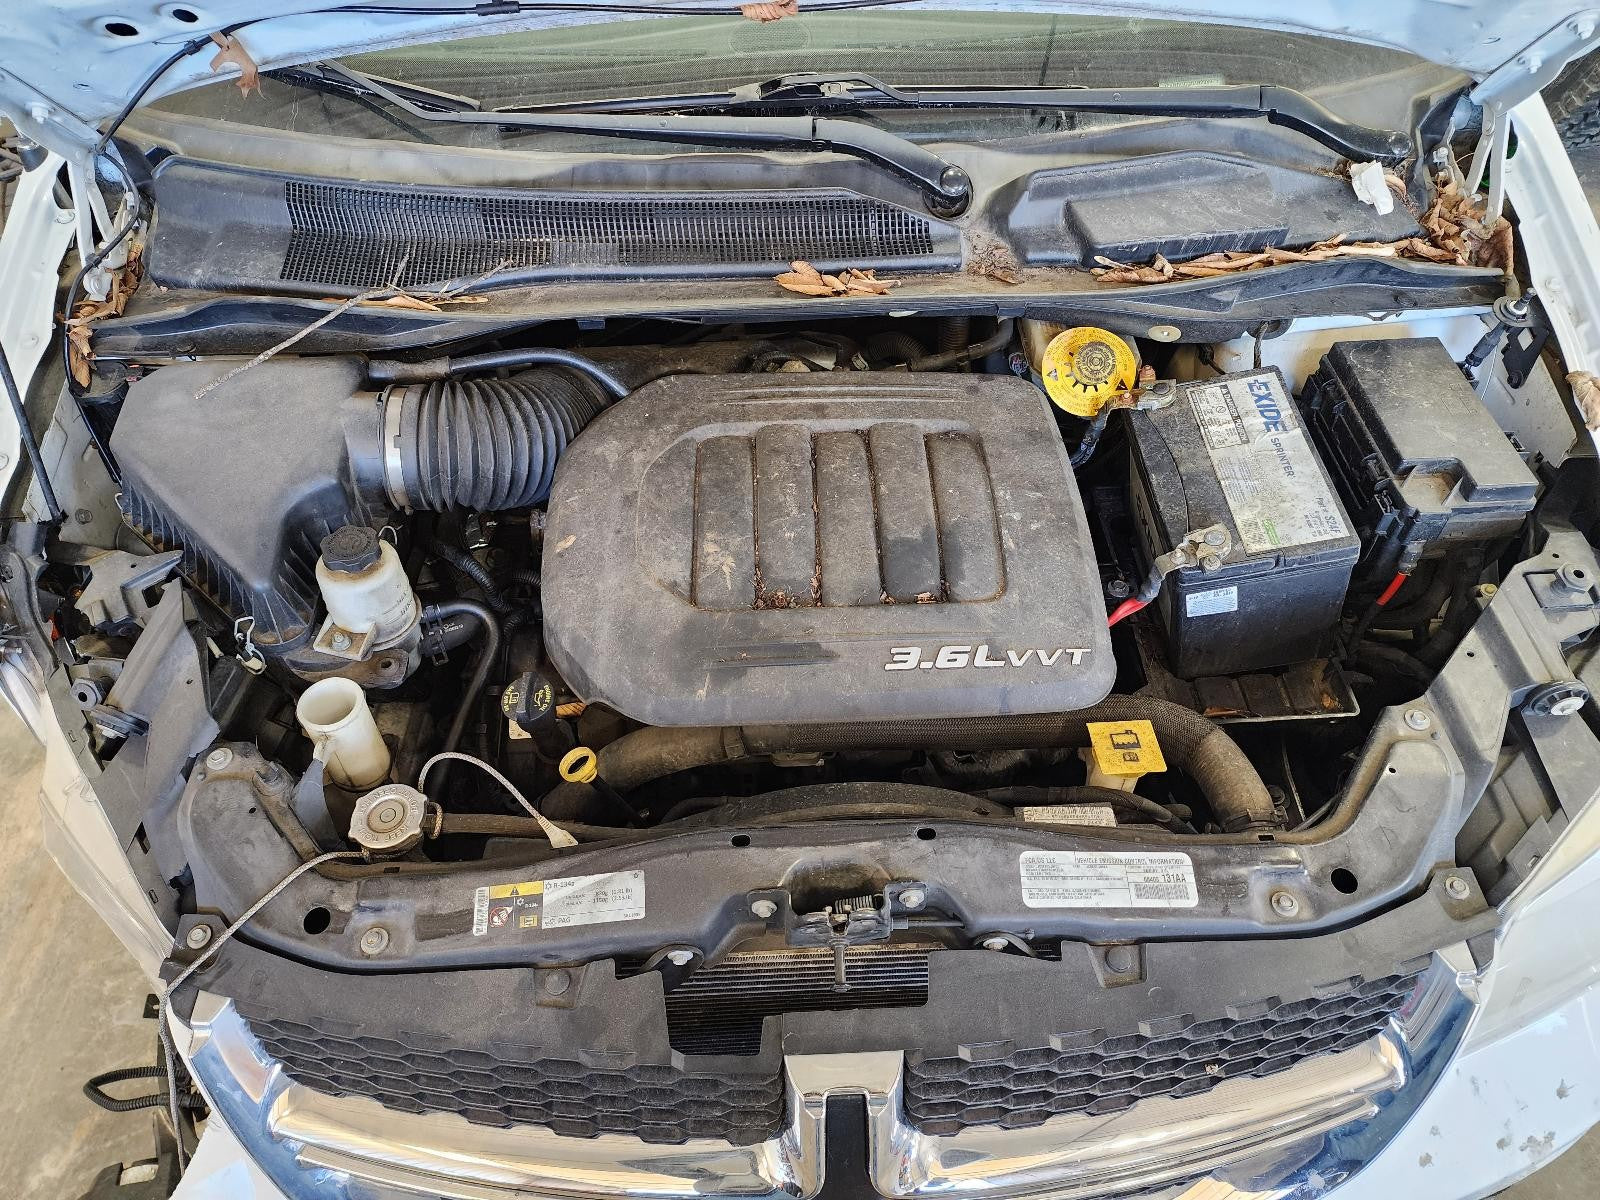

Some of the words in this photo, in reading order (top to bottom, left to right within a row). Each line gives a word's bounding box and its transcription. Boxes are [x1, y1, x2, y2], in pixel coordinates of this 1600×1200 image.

[1247, 379, 1282, 433] EXIDE
[1270, 437, 1294, 478] SPRINTER
[538, 703, 548, 712] OIL
[1161, 873, 1187, 883] 131AA
